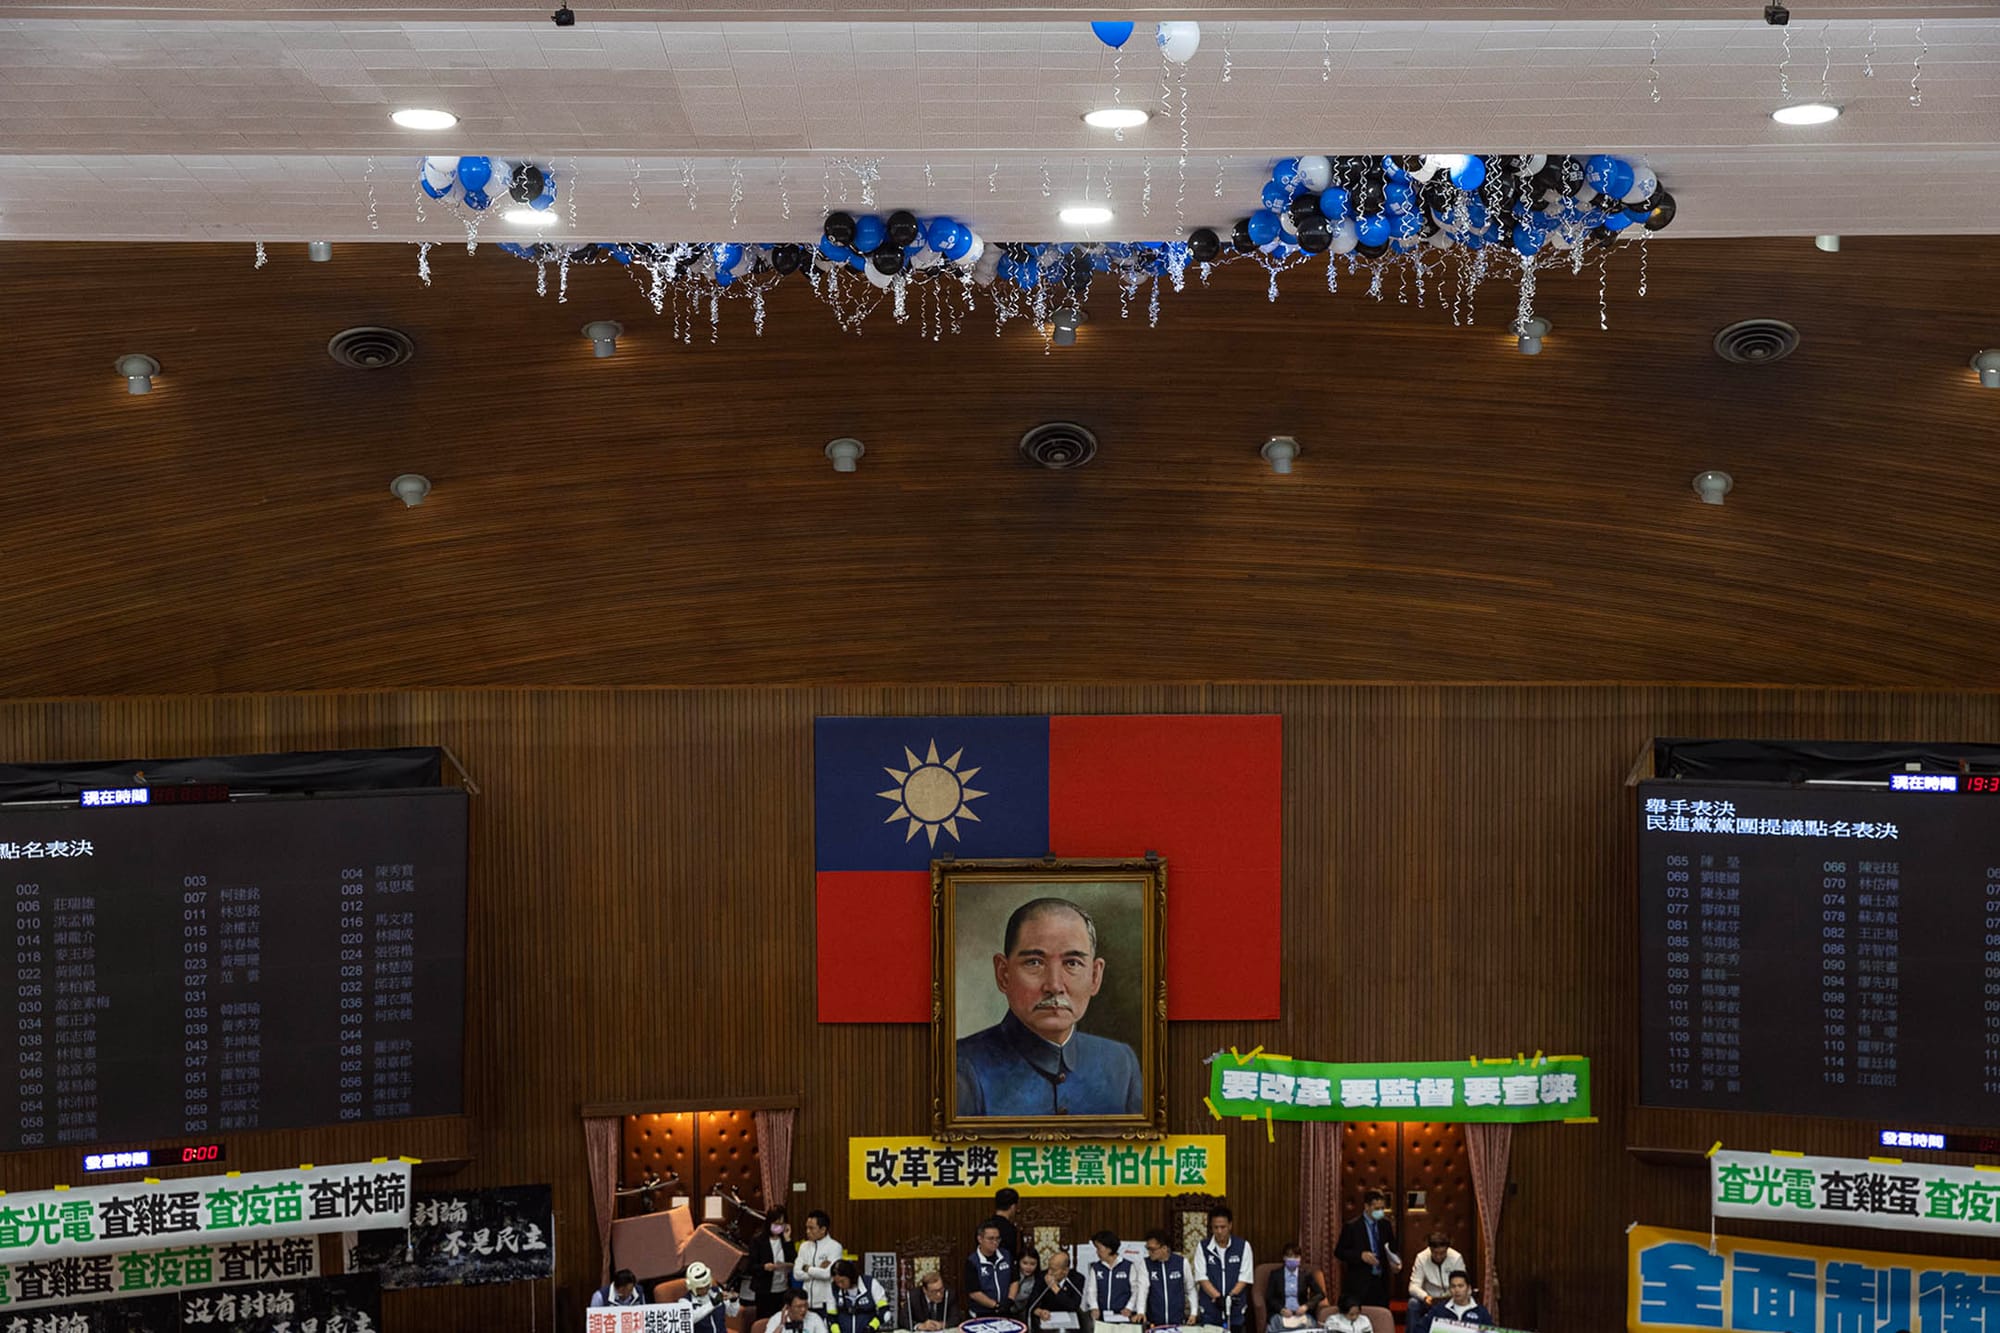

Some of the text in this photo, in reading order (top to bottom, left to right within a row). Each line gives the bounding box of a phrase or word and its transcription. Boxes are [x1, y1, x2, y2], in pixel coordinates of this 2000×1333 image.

[83, 789, 148, 805] 現在時間
[1645, 798, 1736, 818] 舉手表決
[1646, 815, 1899, 840] 民進黨黨團提議點名表決
[1667, 856, 1689, 866] 065
[1823, 862, 1845, 872] 066
[341, 868, 363, 879] 004
[1667, 872, 1689, 882] 069
[184, 876, 208, 888] 003
[1823, 878, 1845, 888] 070
[16, 884, 39, 896] 002
[341, 884, 363, 895] 008
[1667, 888, 1689, 898] 073
[184, 892, 208, 904] 007
[1823, 894, 1845, 905] 074
[16, 900, 39, 912] 006
[341, 900, 363, 912] 012
[1667, 904, 1689, 914] 077
[184, 909, 208, 920] 011
[1823, 910, 1845, 921] 078
[17, 918, 40, 930] 010
[341, 916, 363, 928] 016
[1667, 920, 1689, 930] 081
[184, 926, 208, 937] 015
[1823, 927, 1845, 938] 082
[17, 935, 40, 947] 014
[341, 933, 363, 944] 020
[1667, 936, 1689, 946] 085
[184, 942, 208, 954] 019
[1823, 943, 1845, 954] 086
[17, 952, 40, 964] 018
[341, 949, 363, 960] 024
[1667, 952, 1689, 962] 089
[184, 958, 208, 970] 023
[1823, 960, 1845, 970] 090
[18, 968, 41, 980] 022
[341, 965, 363, 976] 028
[1667, 968, 1689, 978] 093
[184, 974, 208, 986] 027
[1823, 976, 1845, 986] 094
[18, 984, 41, 996] 026
[341, 982, 363, 992] 032
[1667, 984, 1689, 994] 097
[184, 991, 208, 1002] 031
[1823, 992, 1845, 1002] 098
[19, 1002, 42, 1014] 030
[341, 998, 363, 1008] 036
[1669, 1000, 1689, 1010] 101
[184, 1008, 208, 1019] 035
[341, 1014, 363, 1024] 040
[1824, 1008, 1845, 1019] 102
[19, 1018, 42, 1030] 034
[1669, 1016, 1689, 1026] 105
[184, 1024, 208, 1036] 039
[341, 1030, 363, 1040] 044
[1824, 1024, 1845, 1035] 106
[19, 1034, 42, 1046] 038
[1669, 1032, 1689, 1042] 109
[184, 1040, 208, 1052] 043
[341, 1046, 363, 1056] 048
[1824, 1040, 1845, 1051] 110
[19, 1051, 42, 1063] 042
[1669, 1048, 1689, 1058] 113
[184, 1056, 208, 1068] 047
[341, 1061, 363, 1072] 052
[1824, 1056, 1845, 1067] 114
[20, 1068, 43, 1080] 046
[1669, 1063, 1689, 1074] 117
[184, 1072, 208, 1084] 051
[341, 1077, 363, 1088] 056
[1824, 1072, 1845, 1083] 118
[20, 1084, 43, 1096] 050
[1669, 1079, 1689, 1090] 121
[184, 1088, 208, 1100] 055
[341, 1092, 363, 1104] 060
[20, 1100, 43, 1112] 054
[184, 1104, 208, 1116] 059
[341, 1108, 363, 1120] 064
[20, 1117, 43, 1129] 058
[184, 1120, 208, 1132] 063
[21, 1134, 44, 1146] 062
[182, 1145, 219, 1162] 0:00
[866, 1144, 1207, 1187] 改革查弊 民進黨怕什麼
[1717, 1163, 2000, 1223] 查光電 查雞蛋 查疫
[0, 1172, 405, 1249] 查光電 查雞蛋 查疫苗 查快篩
[413, 1198, 468, 1226] 討論
[443, 1224, 547, 1257] 不是民主
[15, 1254, 114, 1302] 查雞蛋
[118, 1244, 214, 1292] 查疫苗
[219, 1237, 313, 1282] 查快篩
[183, 1289, 295, 1324] 沒有討論
